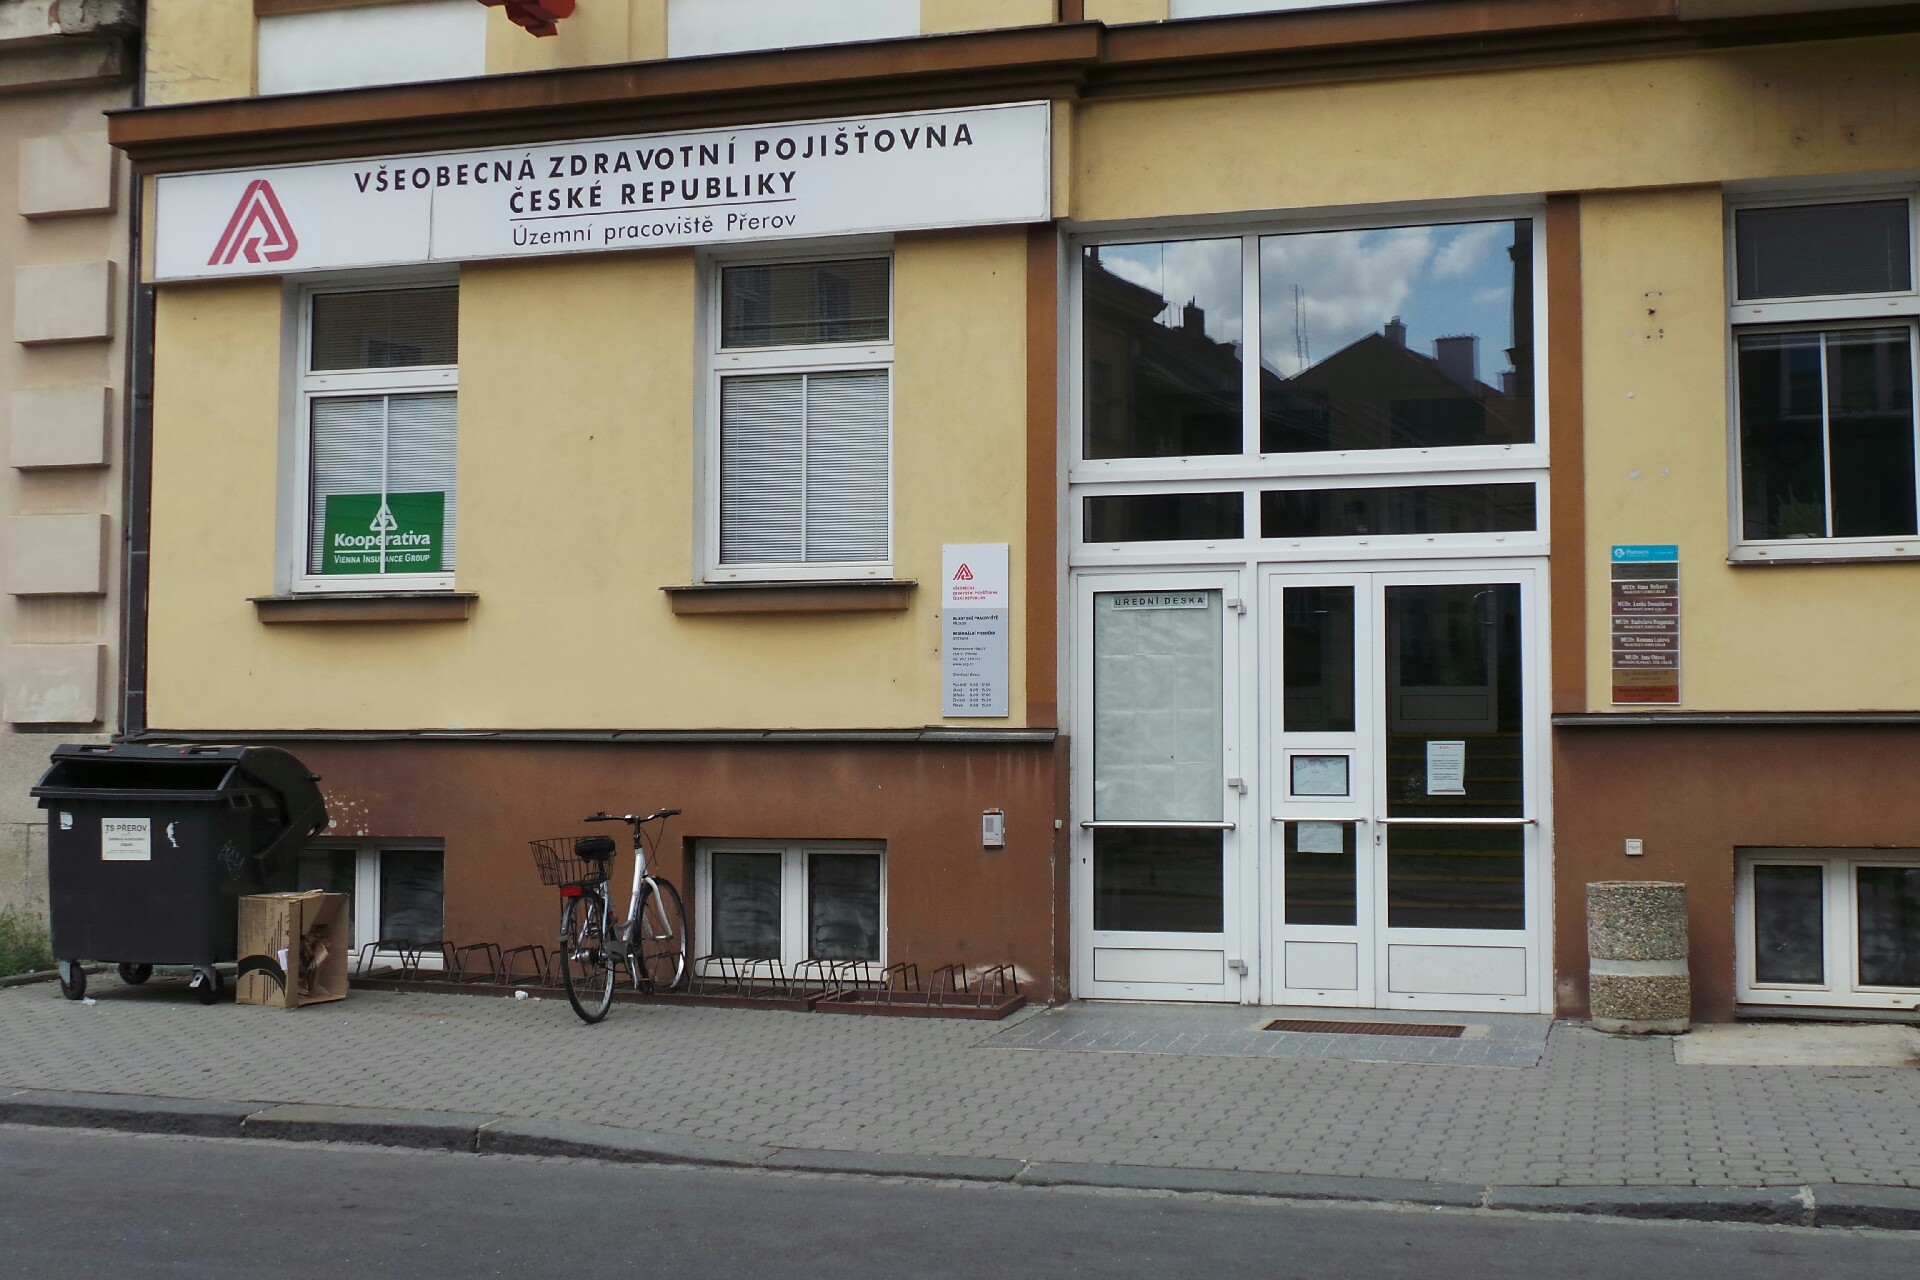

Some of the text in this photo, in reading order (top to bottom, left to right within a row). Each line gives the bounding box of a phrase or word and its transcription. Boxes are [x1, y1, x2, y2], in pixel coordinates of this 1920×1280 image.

[355, 123, 973, 193] VŠEOBECNÁ ZDRAVOTNÍ POJIŠŤOVNA
[509, 170, 797, 214] ČESKÉ REPUBLIKY
[513, 212, 797, 247] Územní pracoviště Přerov
[334, 530, 431, 549] Kooperativa
[1165, 597, 1204, 605] DESKA
[105, 823, 147, 832] TS PŘEROV
